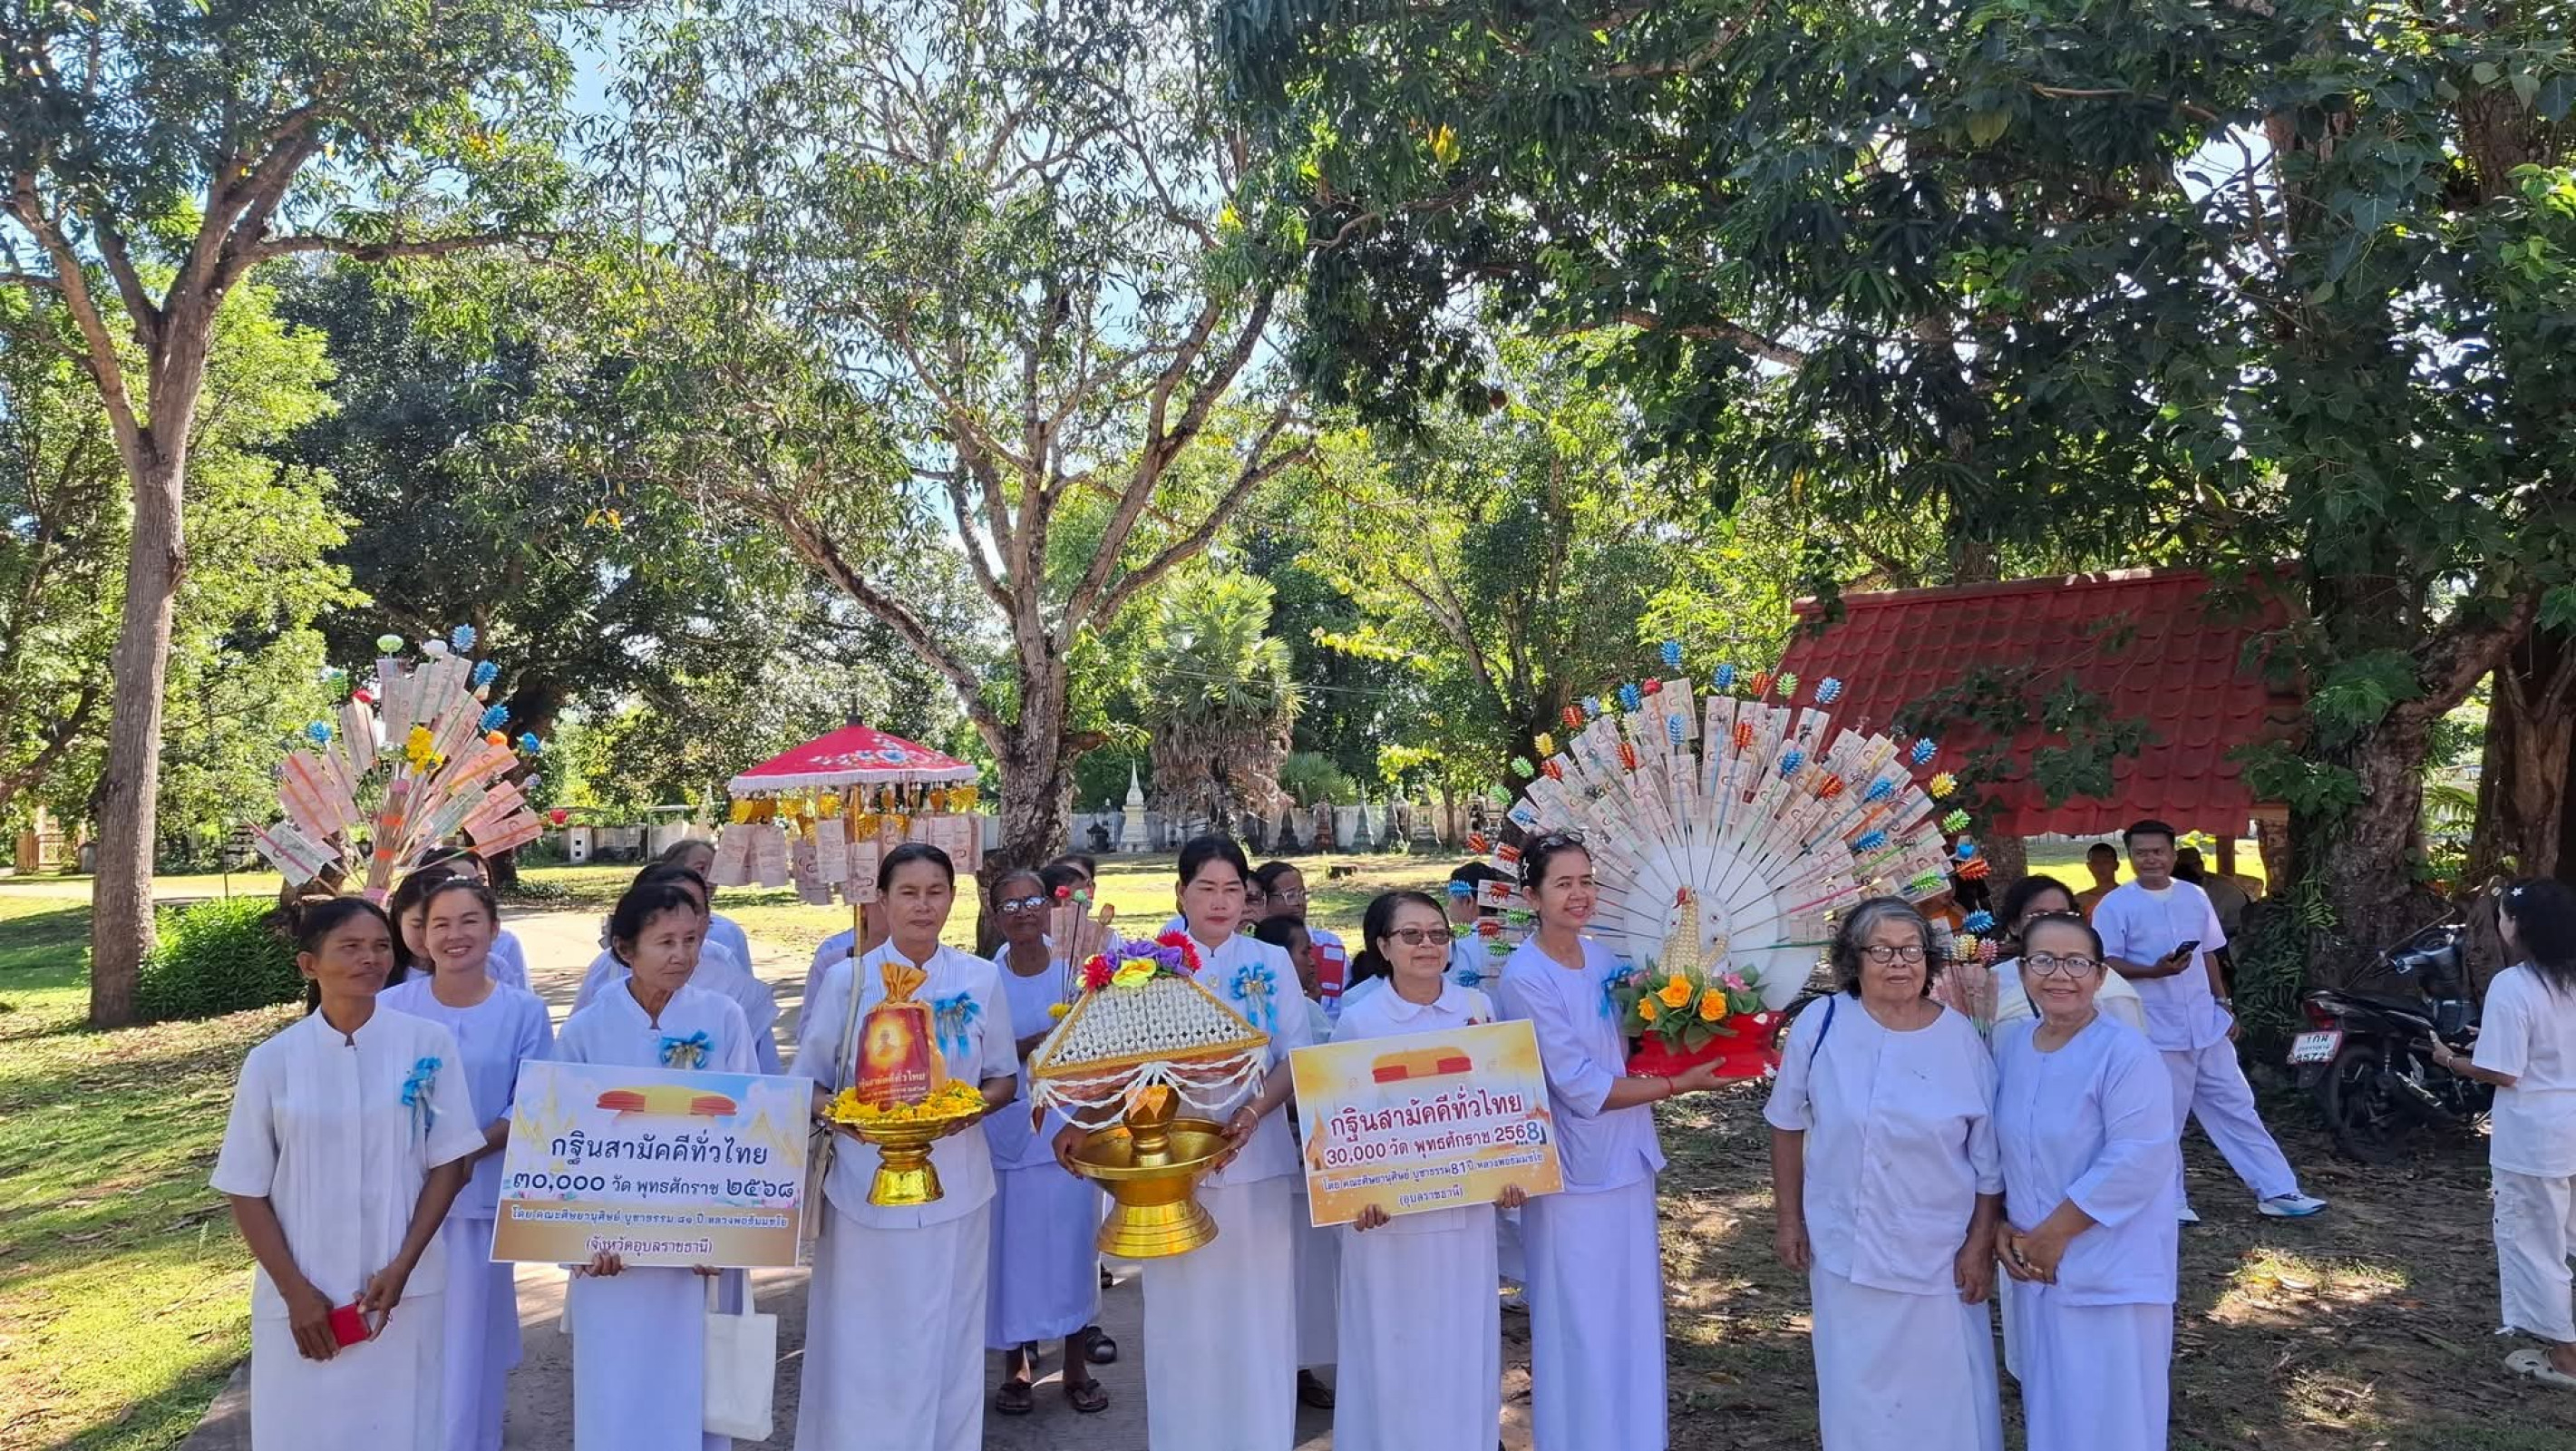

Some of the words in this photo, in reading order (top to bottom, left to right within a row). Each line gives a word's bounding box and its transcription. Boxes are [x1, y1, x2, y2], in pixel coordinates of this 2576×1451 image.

[1330, 1085, 1522, 1143] กฐินสามัคคีทั่วไทย
[551, 1128, 768, 1165] กฐินสามัคคีทั่วไทย
[1326, 1142, 1386, 1165] 30,000
[1389, 1137, 1409, 1155] วัด
[1414, 1129, 1491, 1159] พุทธศักราช
[1493, 1121, 1541, 1143] 2568
[512, 1172, 606, 1193] ๓๐,๐๐๐
[612, 1173, 631, 1193] วัด
[637, 1177, 719, 1199] พุทธศักราช
[726, 1178, 794, 1198] ๒๕๖๘
[1398, 1183, 1464, 1208] (อุบลราชธานี)
[696, 1212, 705, 1224] ปี
[586, 1235, 713, 1257] (จังหวัดอุบลราชธานี)
